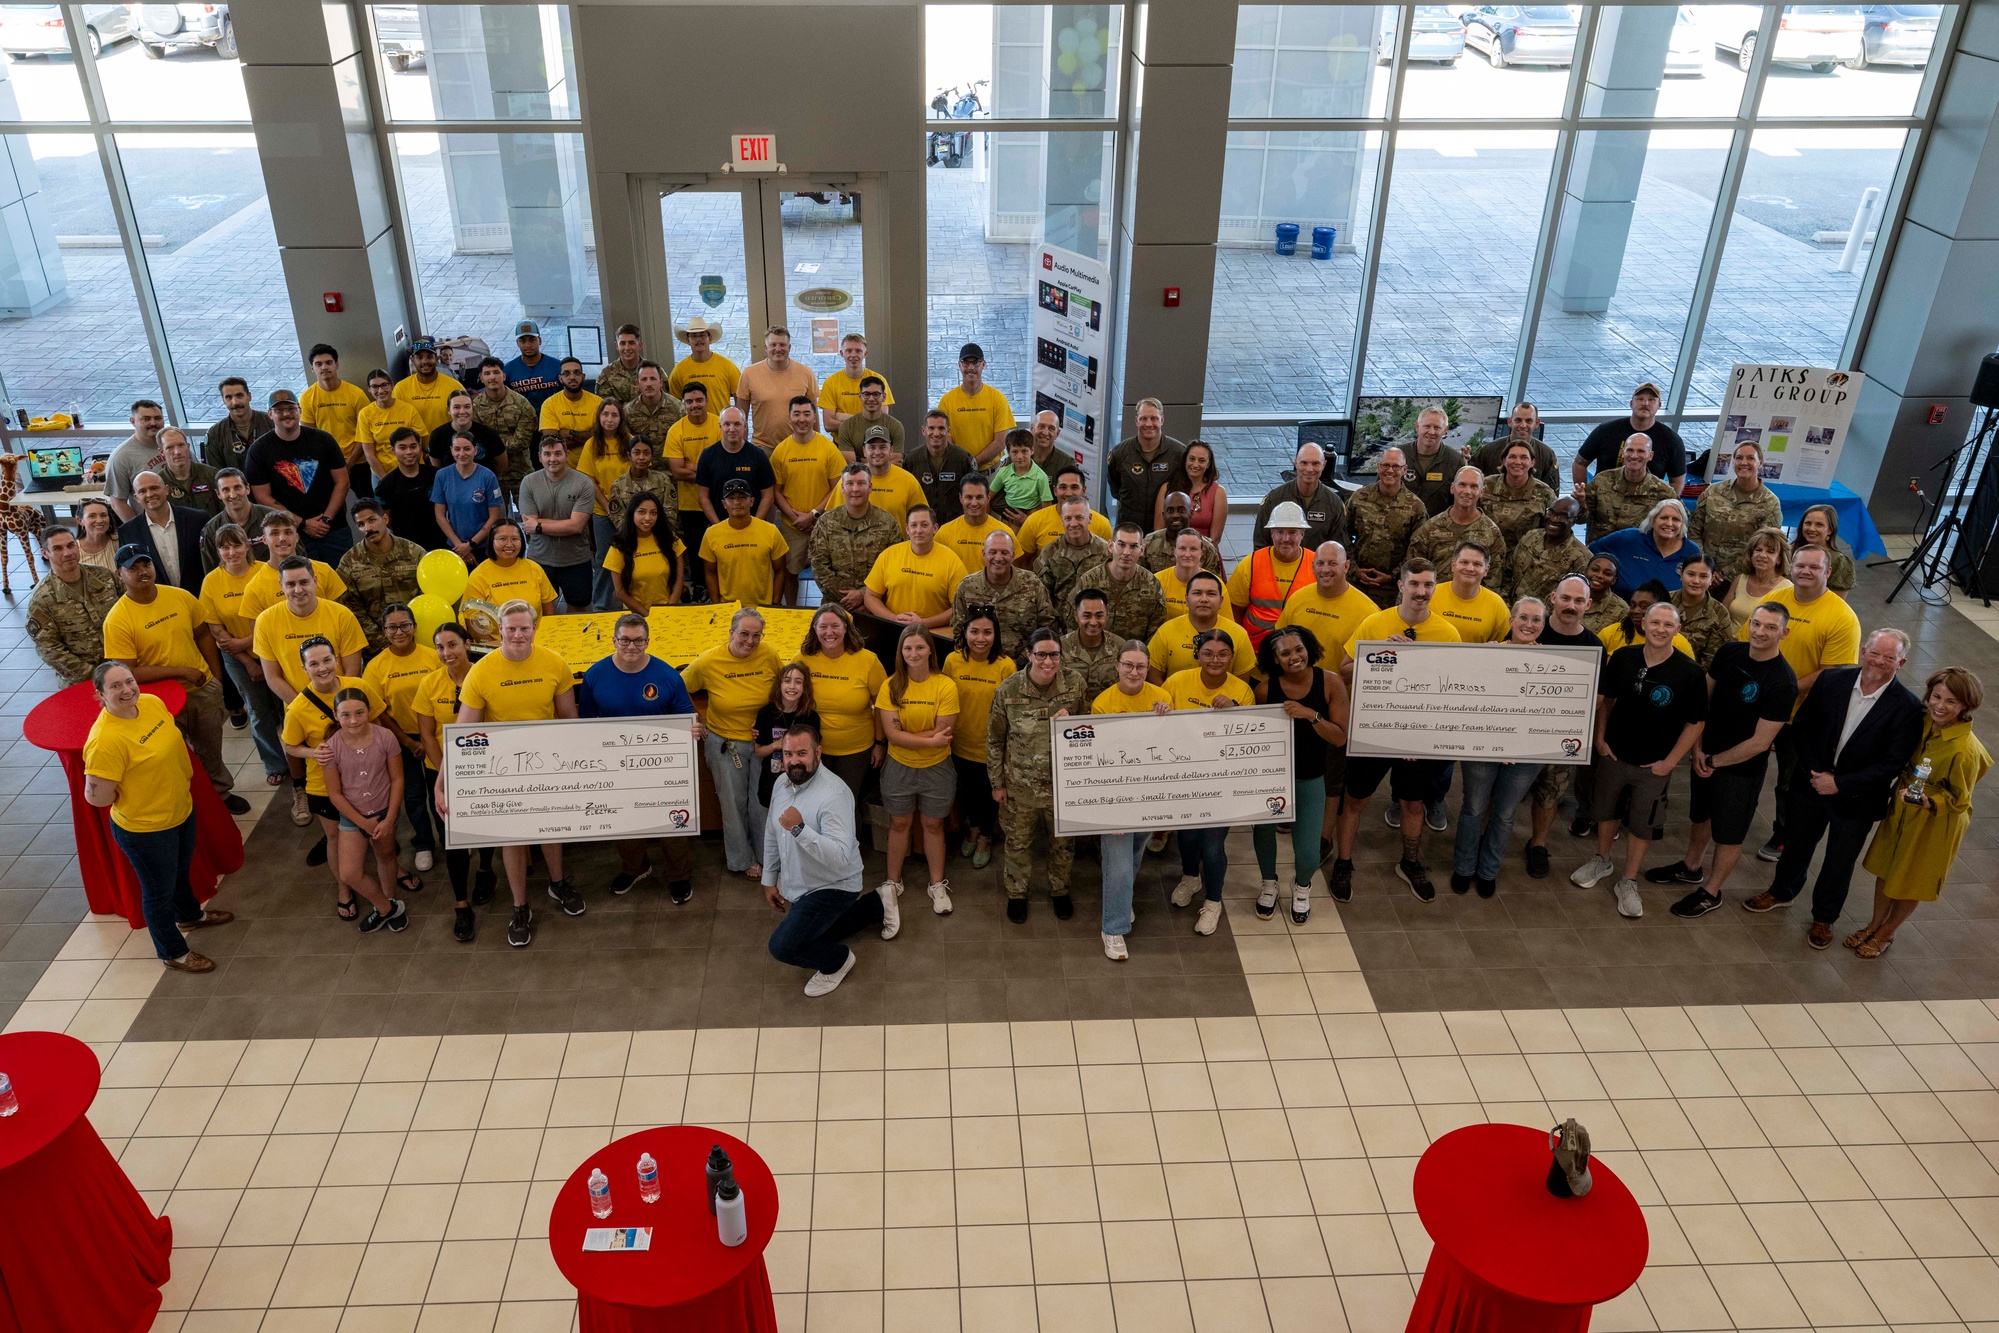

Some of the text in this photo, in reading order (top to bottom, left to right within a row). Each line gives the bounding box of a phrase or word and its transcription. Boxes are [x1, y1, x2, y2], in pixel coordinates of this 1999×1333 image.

[740, 137, 768, 160] EXIT
[1054, 262, 1099, 285] Audio Multimedia
[1736, 367, 1810, 384] 9 ATKS
[1736, 384, 1847, 405] LL GROUP
[1366, 653, 1398, 664] Casa
[1524, 662, 1566, 674] 8/5/25
[1396, 675, 1486, 693] GHOST WARRIORS
[1520, 686, 1525, 694] $
[1385, 702, 1425, 710] Thousand
[1443, 704, 1480, 712] Hundred
[1480, 705, 1509, 713] dollars
[1394, 722, 1408, 730] Big
[1435, 723, 1460, 731] Large
[1486, 724, 1517, 732] Winner
[620, 733, 669, 746] 8/5/25
[1063, 729, 1095, 739] Casa
[455, 736, 489, 747] Casa
[1220, 749, 1225, 757] $
[488, 751, 607, 776] 16 TRS SAVAGES
[620, 760, 625, 768] $
[1083, 776, 1125, 785] Thousand
[1126, 776, 1142, 784] Five
[1143, 773, 1179, 782] Hundred
[1181, 771, 1210, 779] dollars
[1230, 768, 1258, 776] no/100
[457, 788, 477, 796] One
[479, 785, 525, 795] Thousand
[527, 784, 560, 792] dollars
[561, 782, 581, 790] and
[583, 781, 614, 790] no/100
[1100, 796, 1115, 804] Big
[1141, 793, 1166, 801] Small
[1192, 790, 1222, 798] Winner
[491, 802, 505, 810] Big
[506, 800, 523, 808] Give
